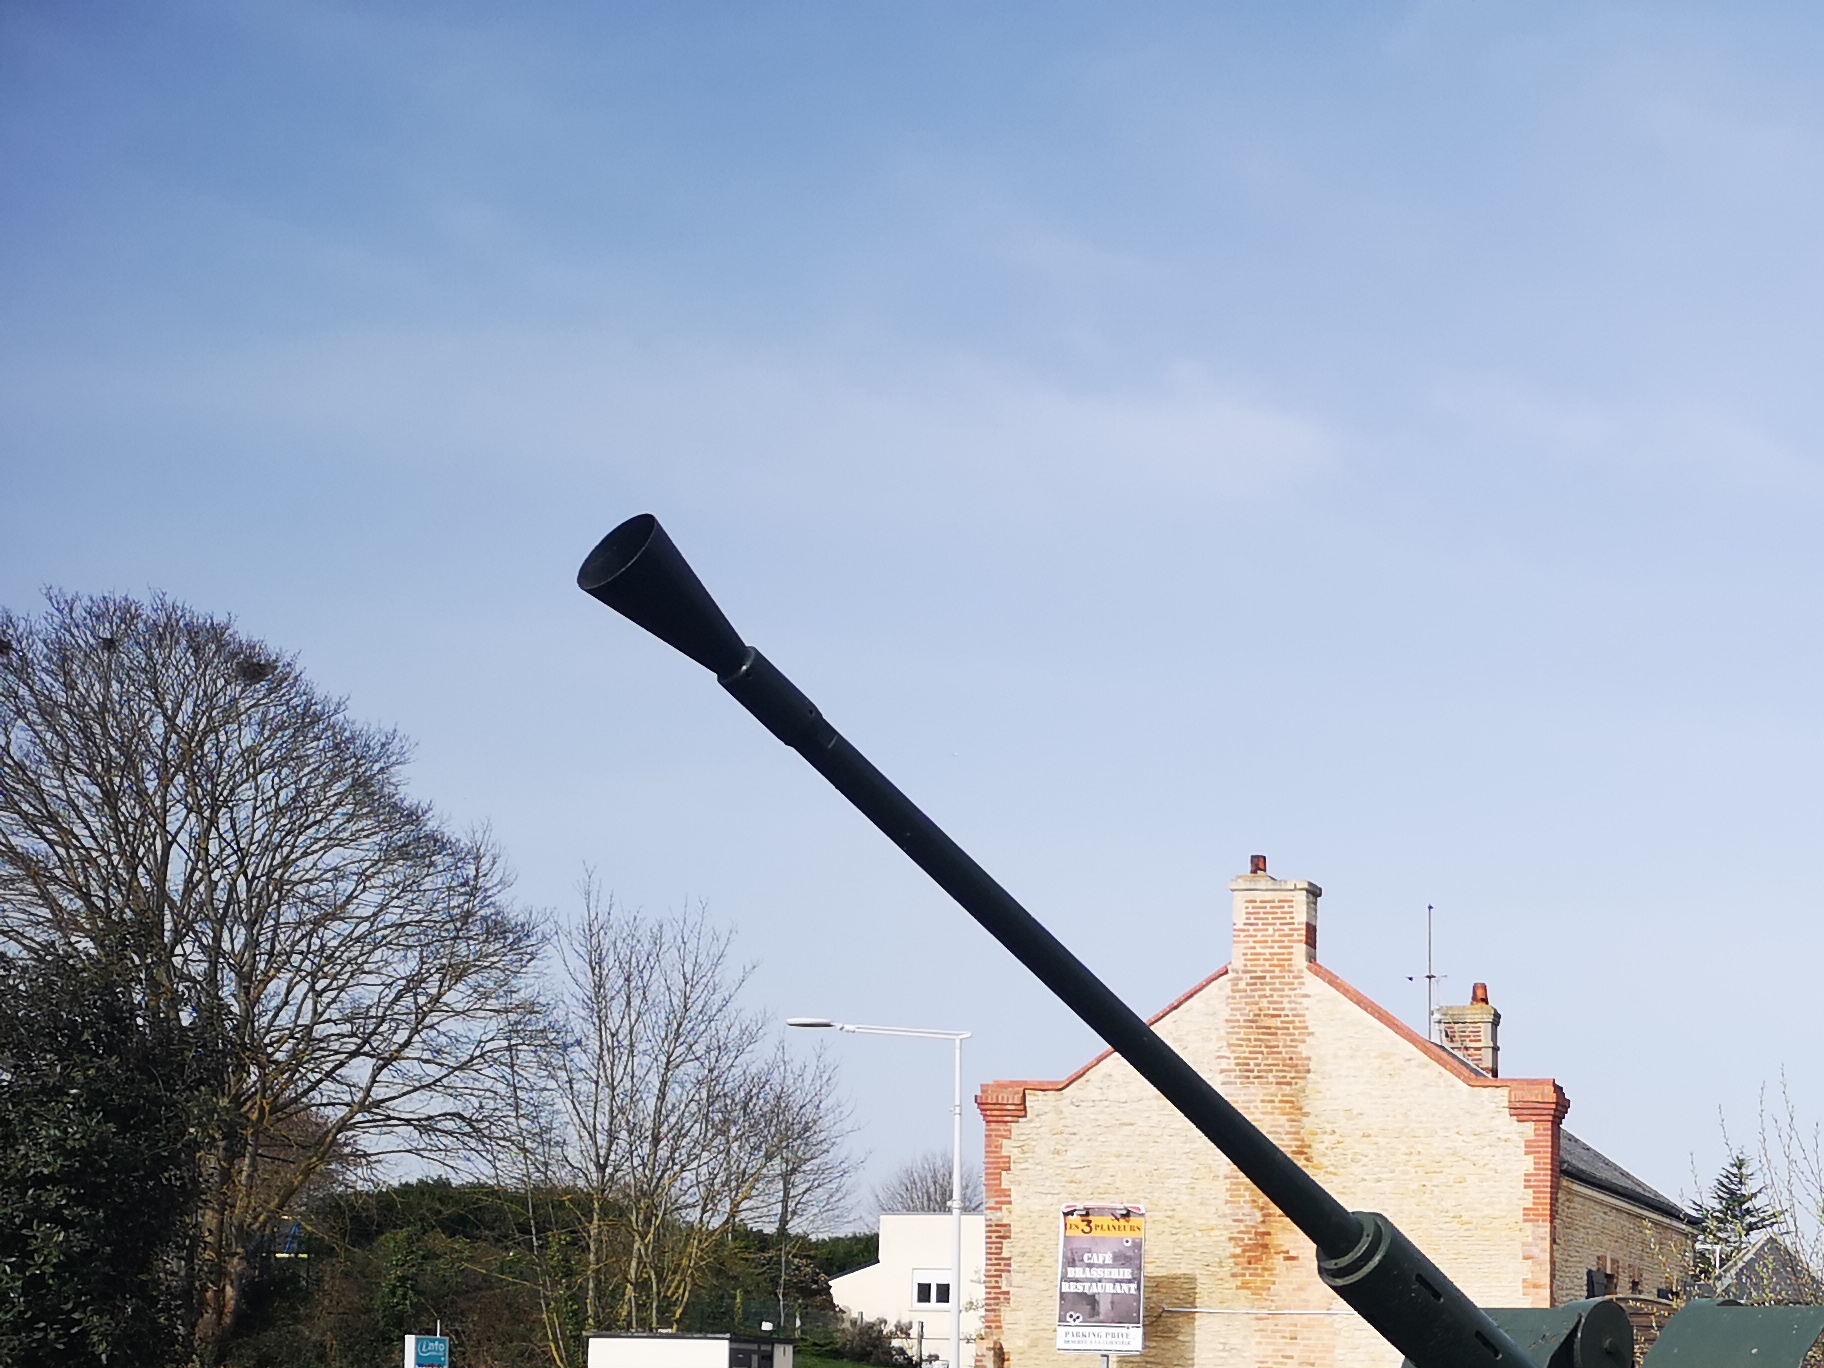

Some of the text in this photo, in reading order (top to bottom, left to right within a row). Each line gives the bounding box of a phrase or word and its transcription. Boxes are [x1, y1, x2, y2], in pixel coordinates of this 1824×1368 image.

[1081, 1219, 1093, 1235] 3
[1094, 1223, 1142, 1233] PLANEURS
[1083, 1252, 1113, 1264] CAFÉ
[1067, 1267, 1133, 1279] BRASSERIE
[1061, 1281, 1138, 1295] RESTAURANT
